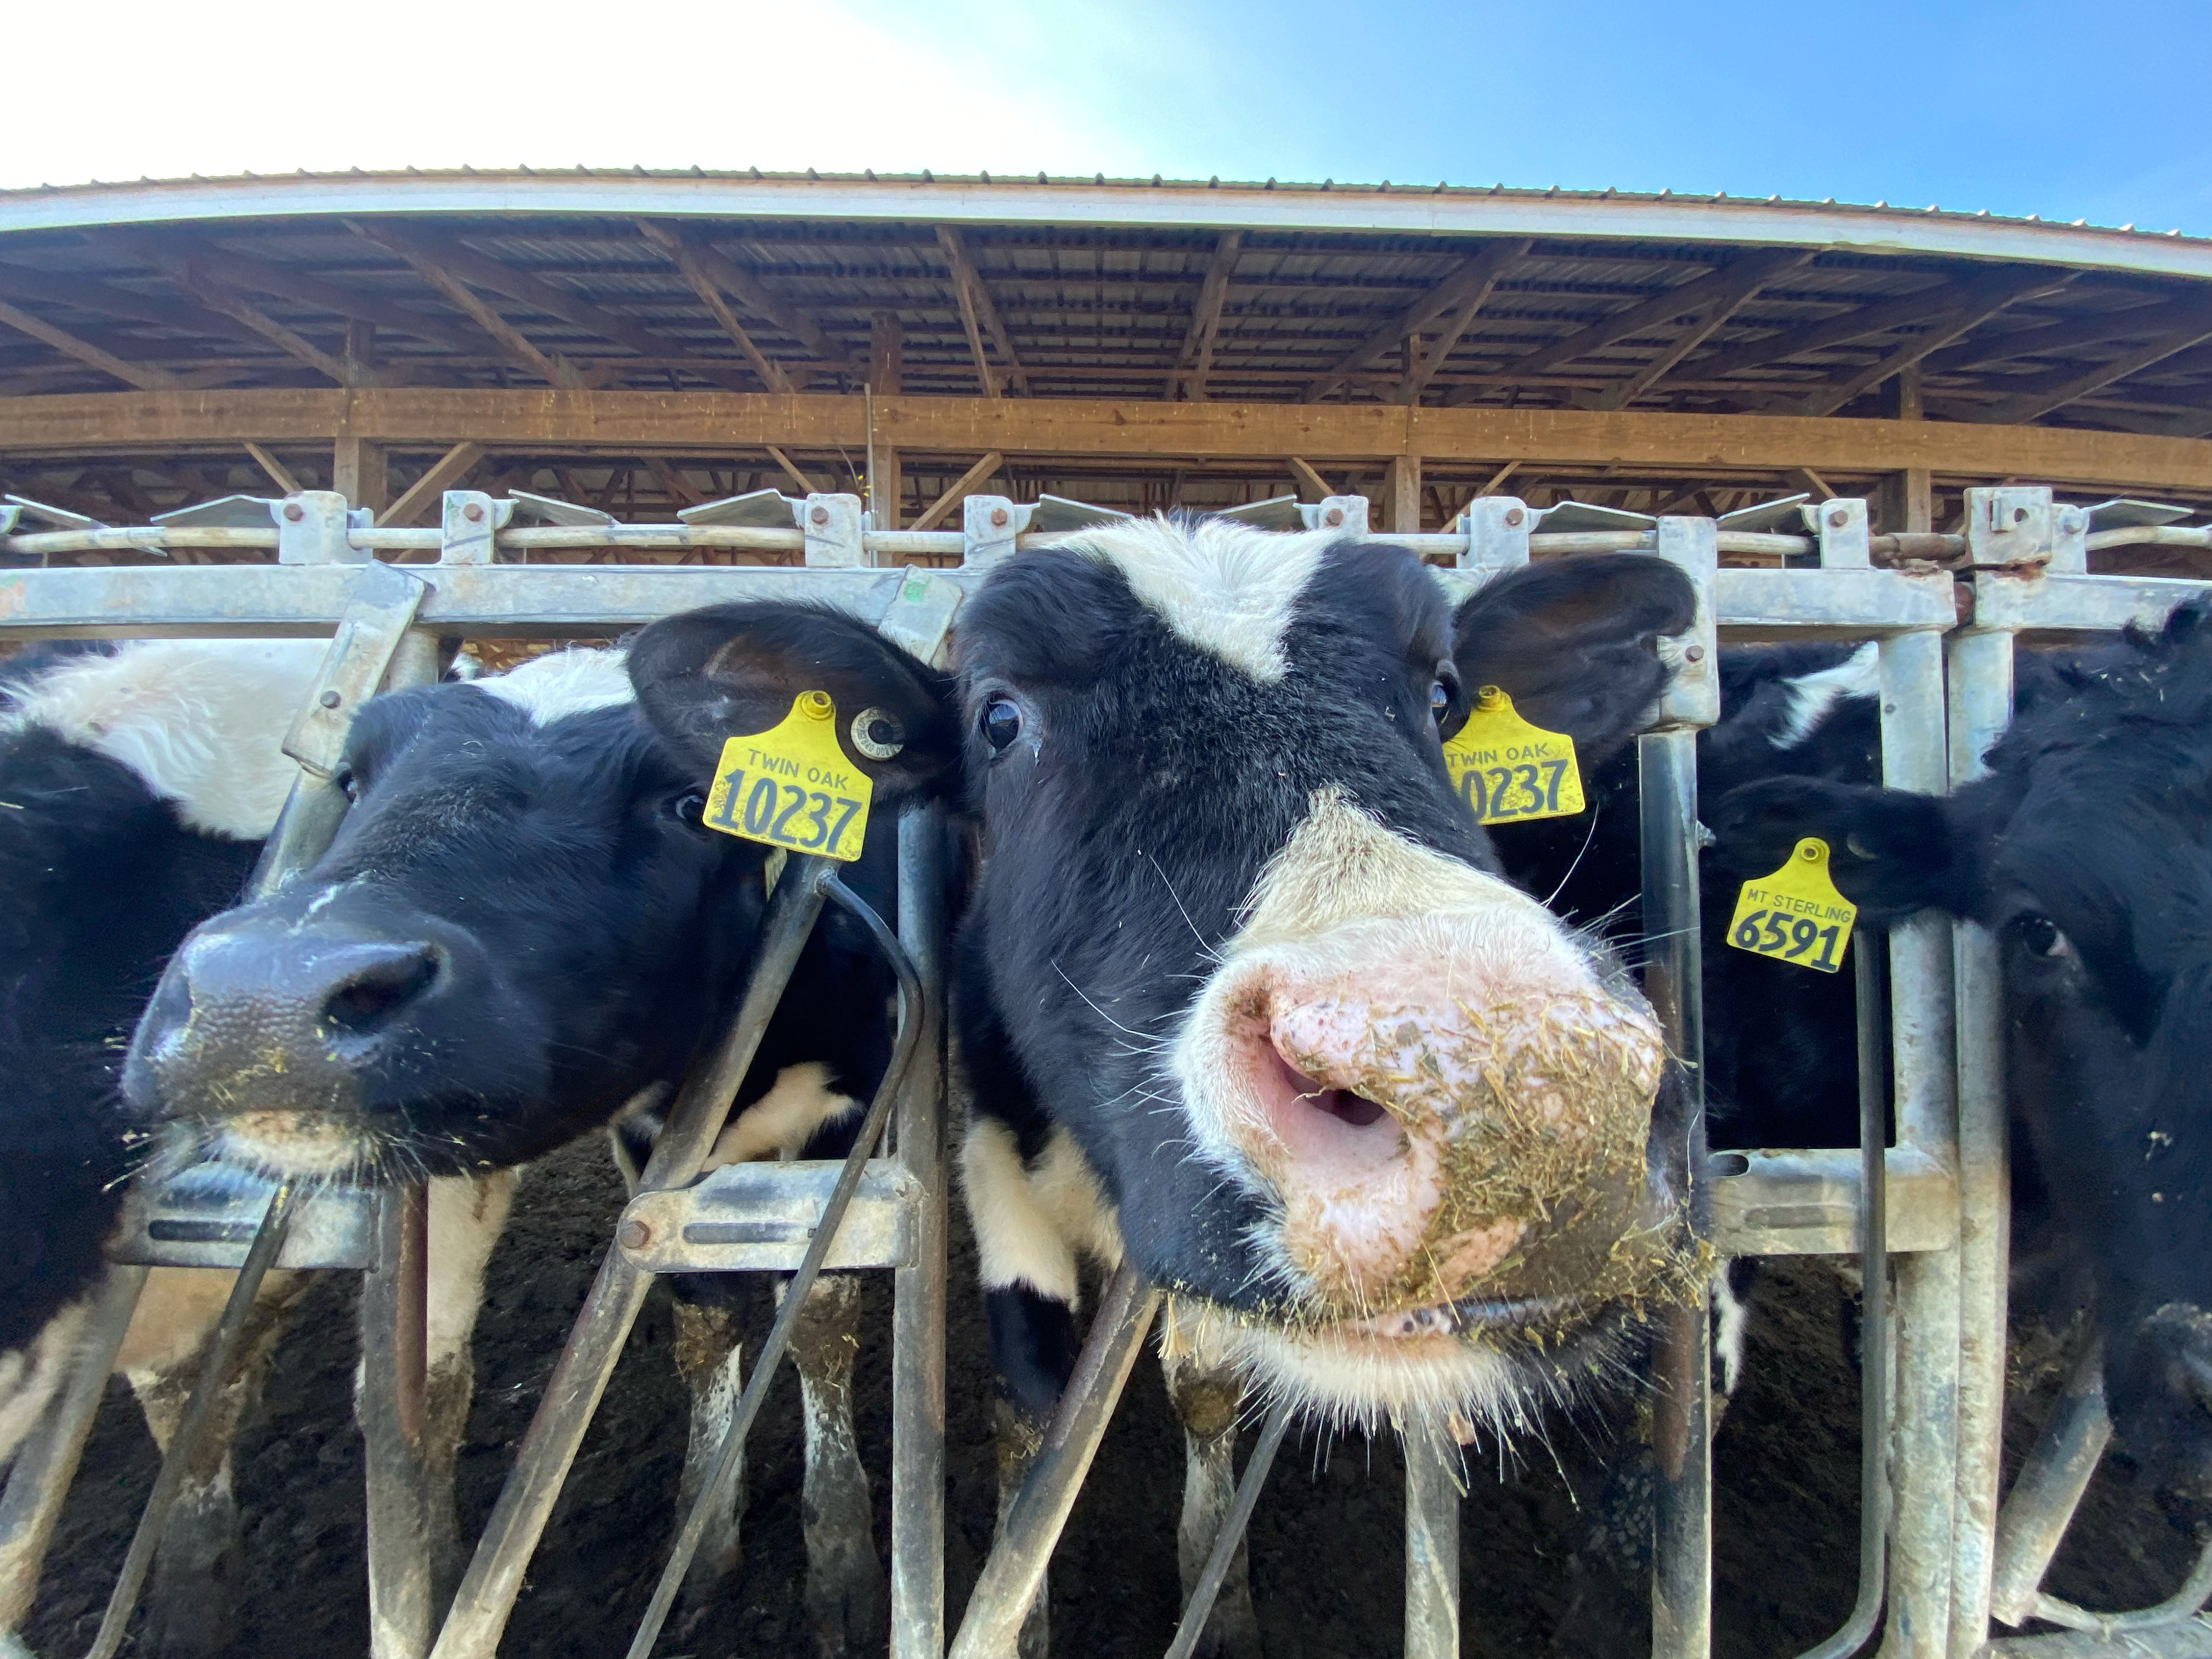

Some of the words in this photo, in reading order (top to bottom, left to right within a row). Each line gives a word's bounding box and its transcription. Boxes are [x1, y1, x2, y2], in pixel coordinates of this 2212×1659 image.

[748, 748, 800, 778] TWIN
[808, 767, 849, 791] OAK
[1446, 749, 1498, 767] TWIN
[1506, 742, 1550, 760] OAK
[711, 768, 863, 853] 10237
[1460, 759, 1567, 820] 0237
[1746, 888, 1769, 903] MT
[1773, 894, 1852, 923] STERLING
[1735, 909, 1841, 971] 6591
